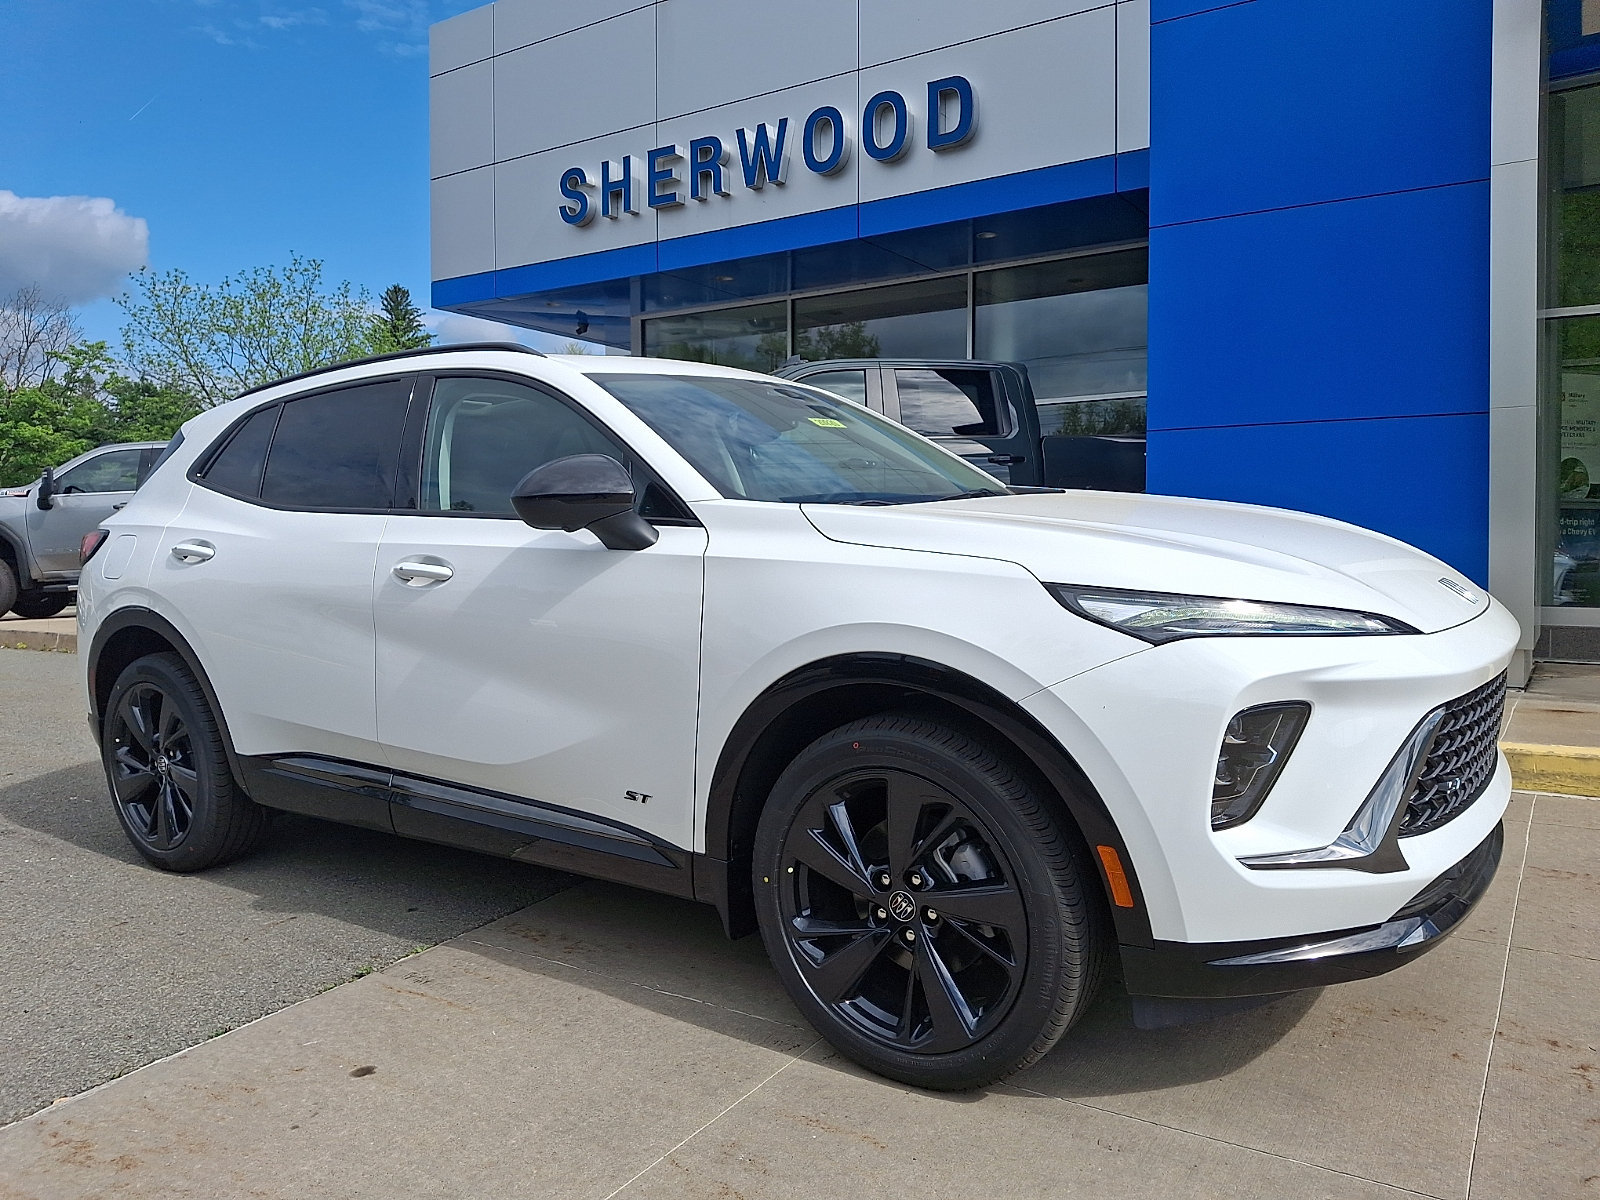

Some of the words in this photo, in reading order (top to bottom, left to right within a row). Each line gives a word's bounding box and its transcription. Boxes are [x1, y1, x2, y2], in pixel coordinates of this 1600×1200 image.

[558, 74, 977, 227] SHERWOOD
[1560, 517, 1579, 527] d-trip
[1567, 527, 1588, 537] Chevy
[623, 789, 653, 804] ST
